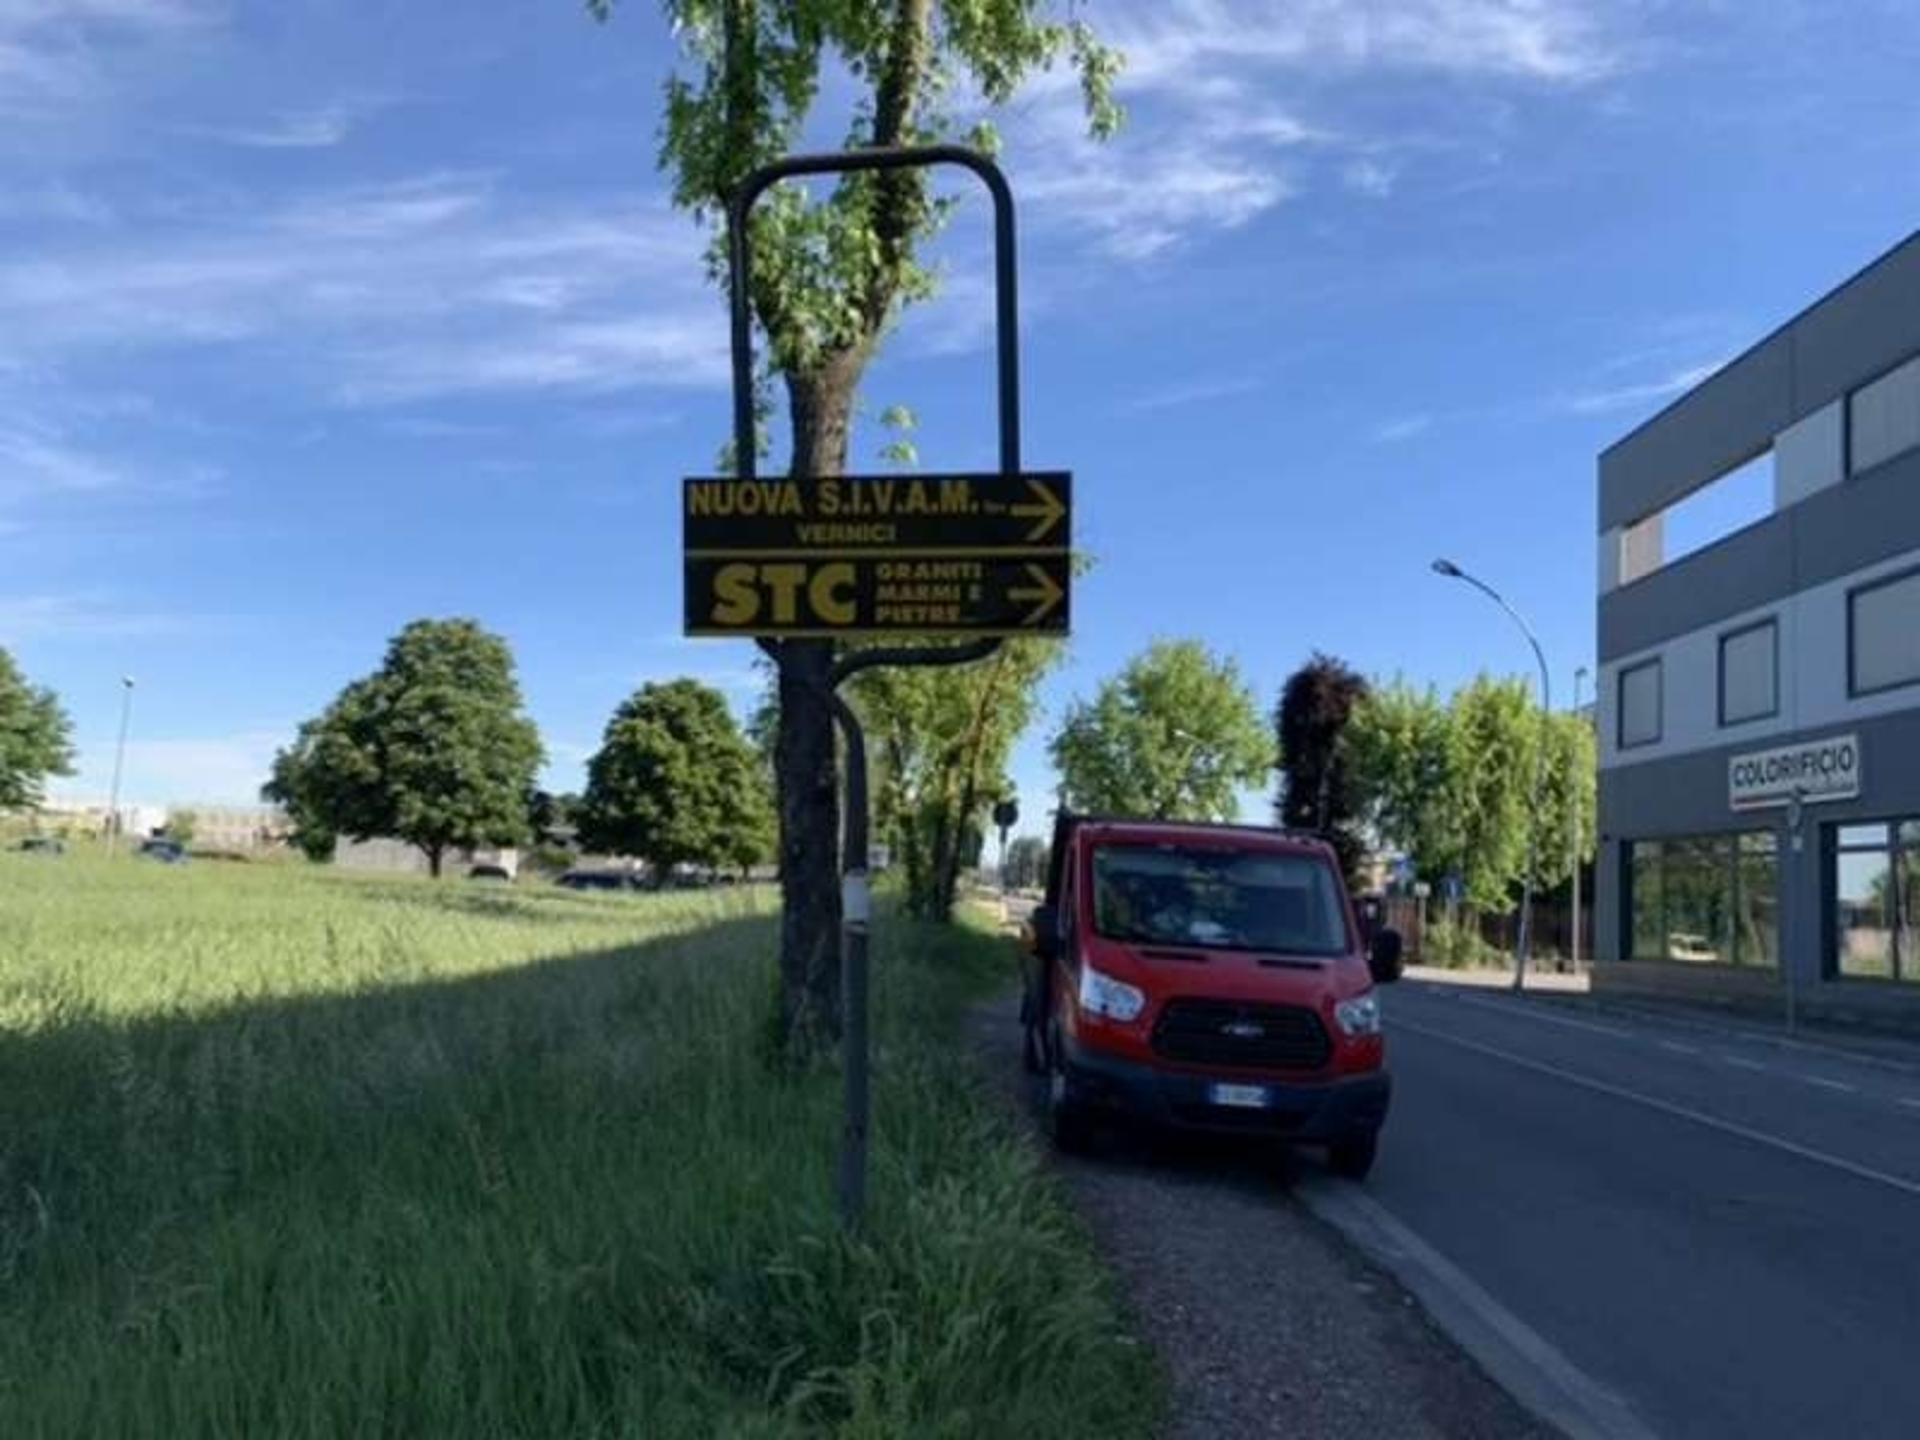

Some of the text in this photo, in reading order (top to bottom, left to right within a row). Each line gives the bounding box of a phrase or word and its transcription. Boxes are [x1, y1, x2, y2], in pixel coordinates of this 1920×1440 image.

[689, 479, 980, 517] NUOVA S.I.V.A.M.
[795, 522, 897, 544] VERNICI
[875, 561, 983, 580] GRANITI
[710, 561, 859, 626] STC
[875, 583, 960, 602] MARMI
[1734, 745, 1853, 787] COLORIFICIO
